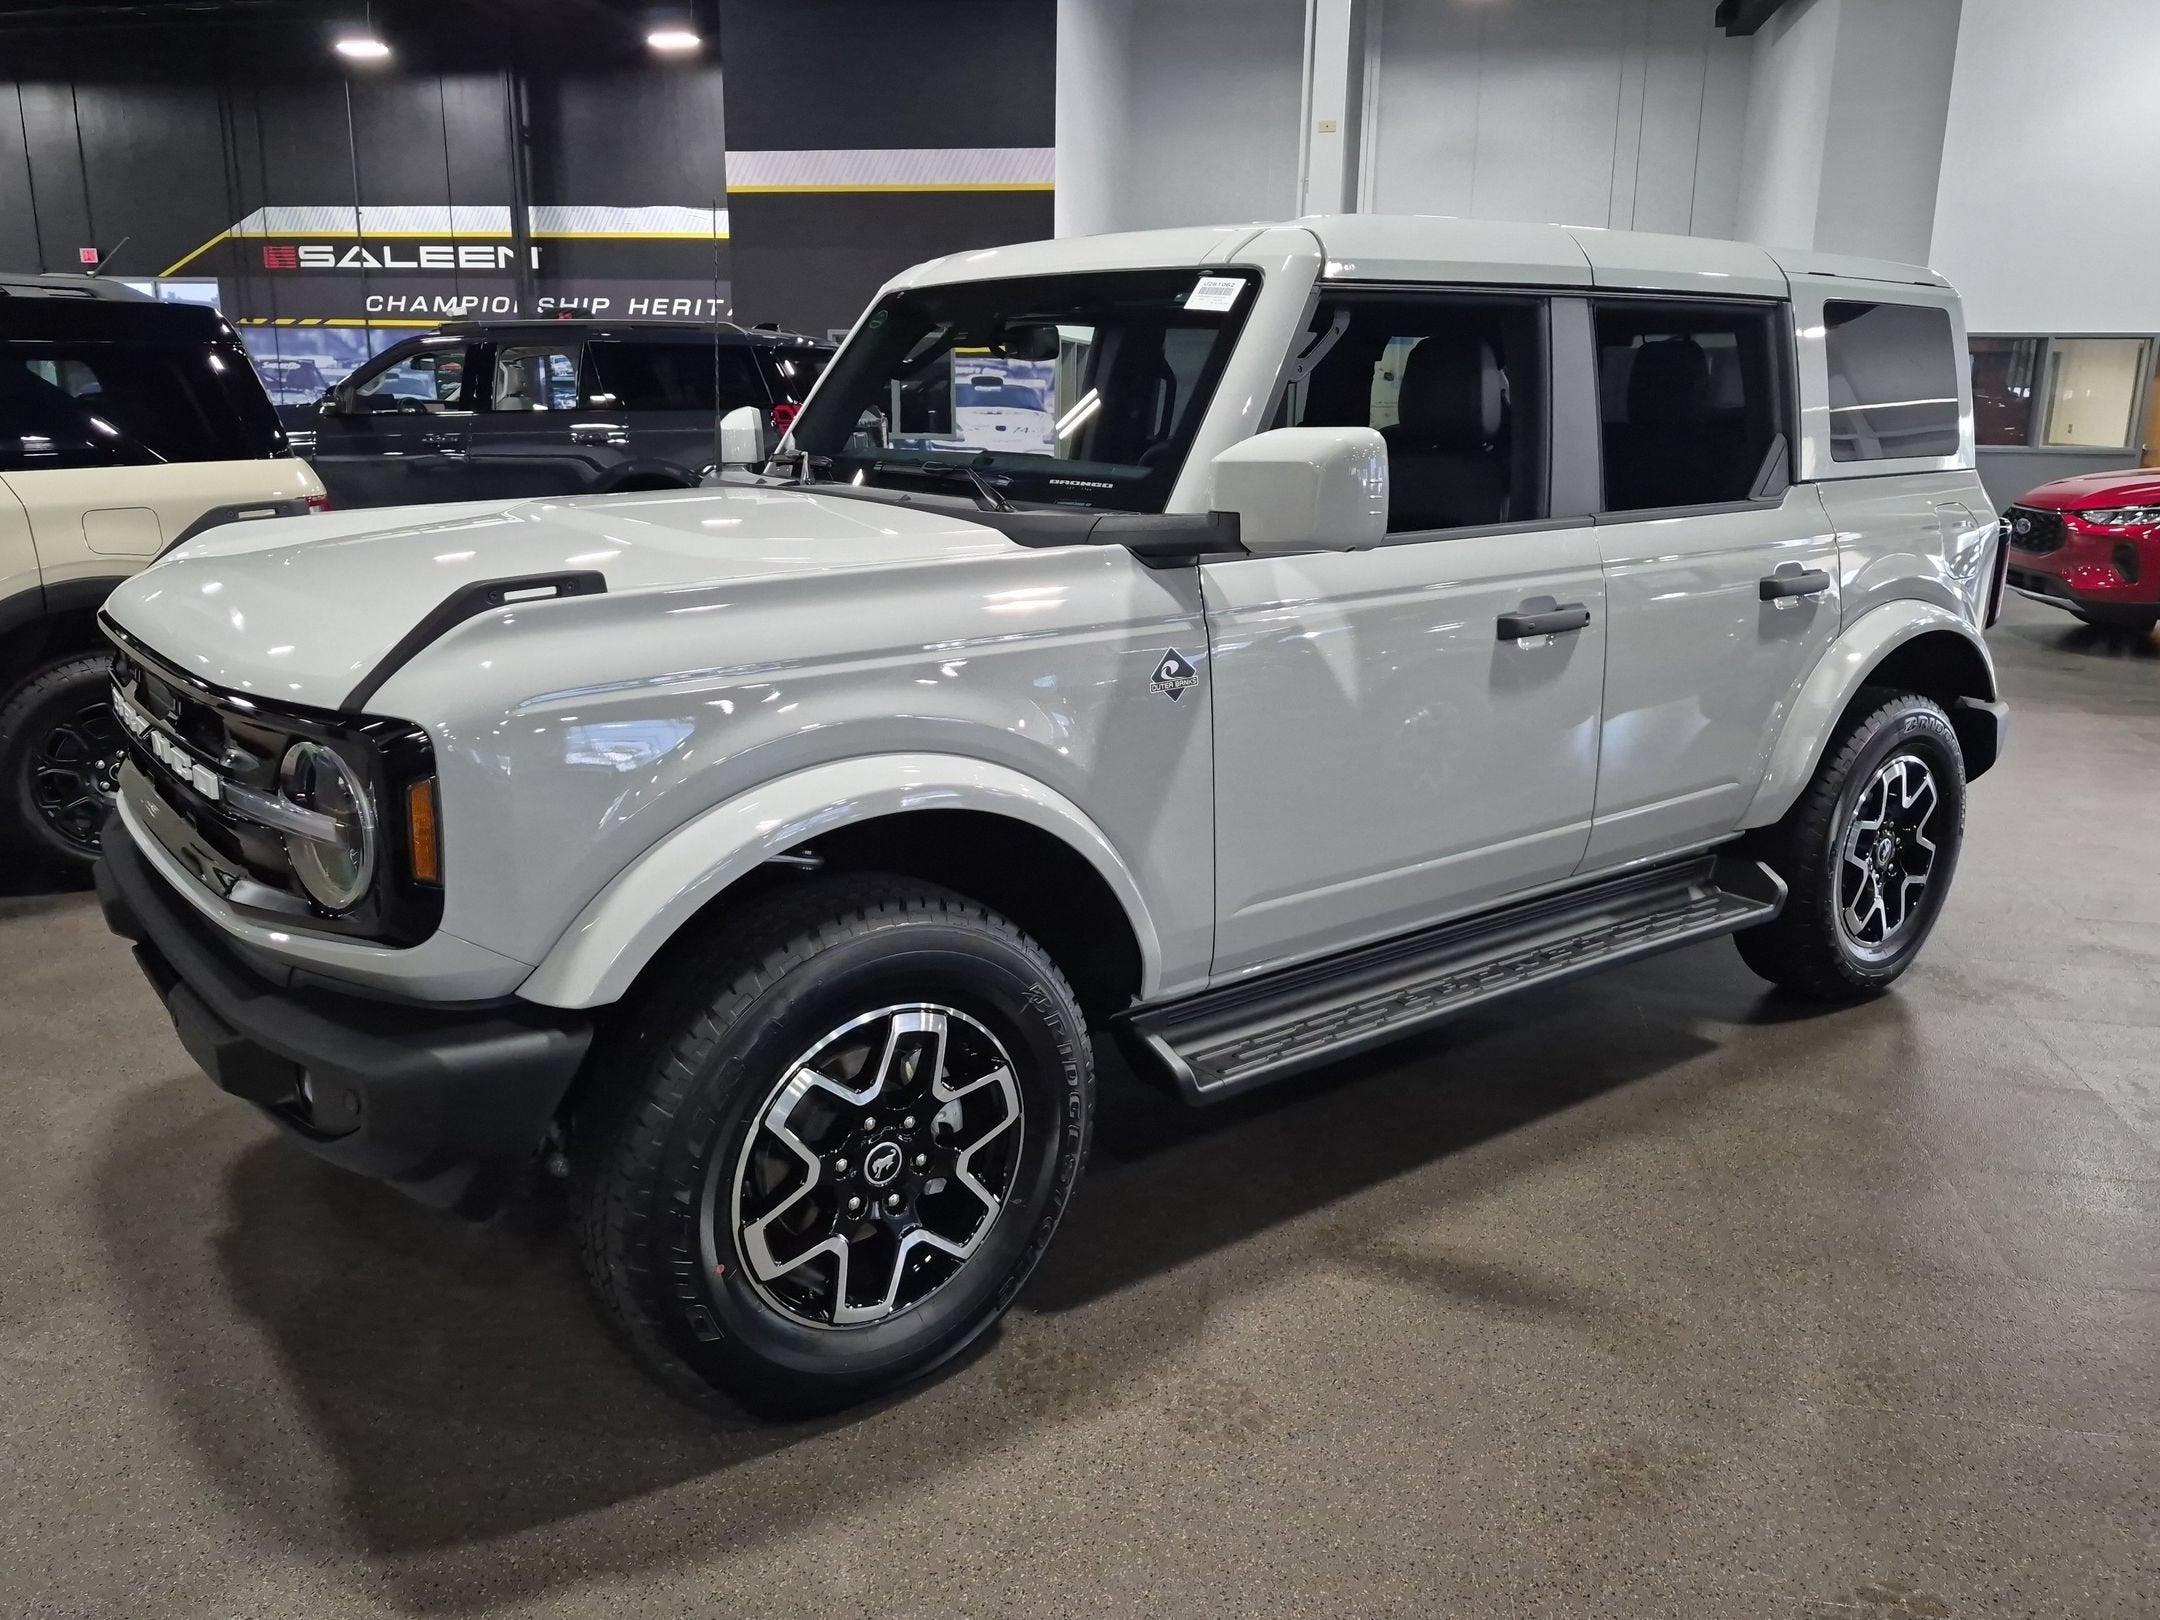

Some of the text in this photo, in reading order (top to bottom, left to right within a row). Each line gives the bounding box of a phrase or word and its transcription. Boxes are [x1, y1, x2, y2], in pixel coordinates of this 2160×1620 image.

[298, 245, 540, 270] SALEEN
[628, 297, 734, 317] HERIT
[1049, 479, 1114, 488] BRONCO
[1151, 678, 1197, 691] OUTER BANKS
